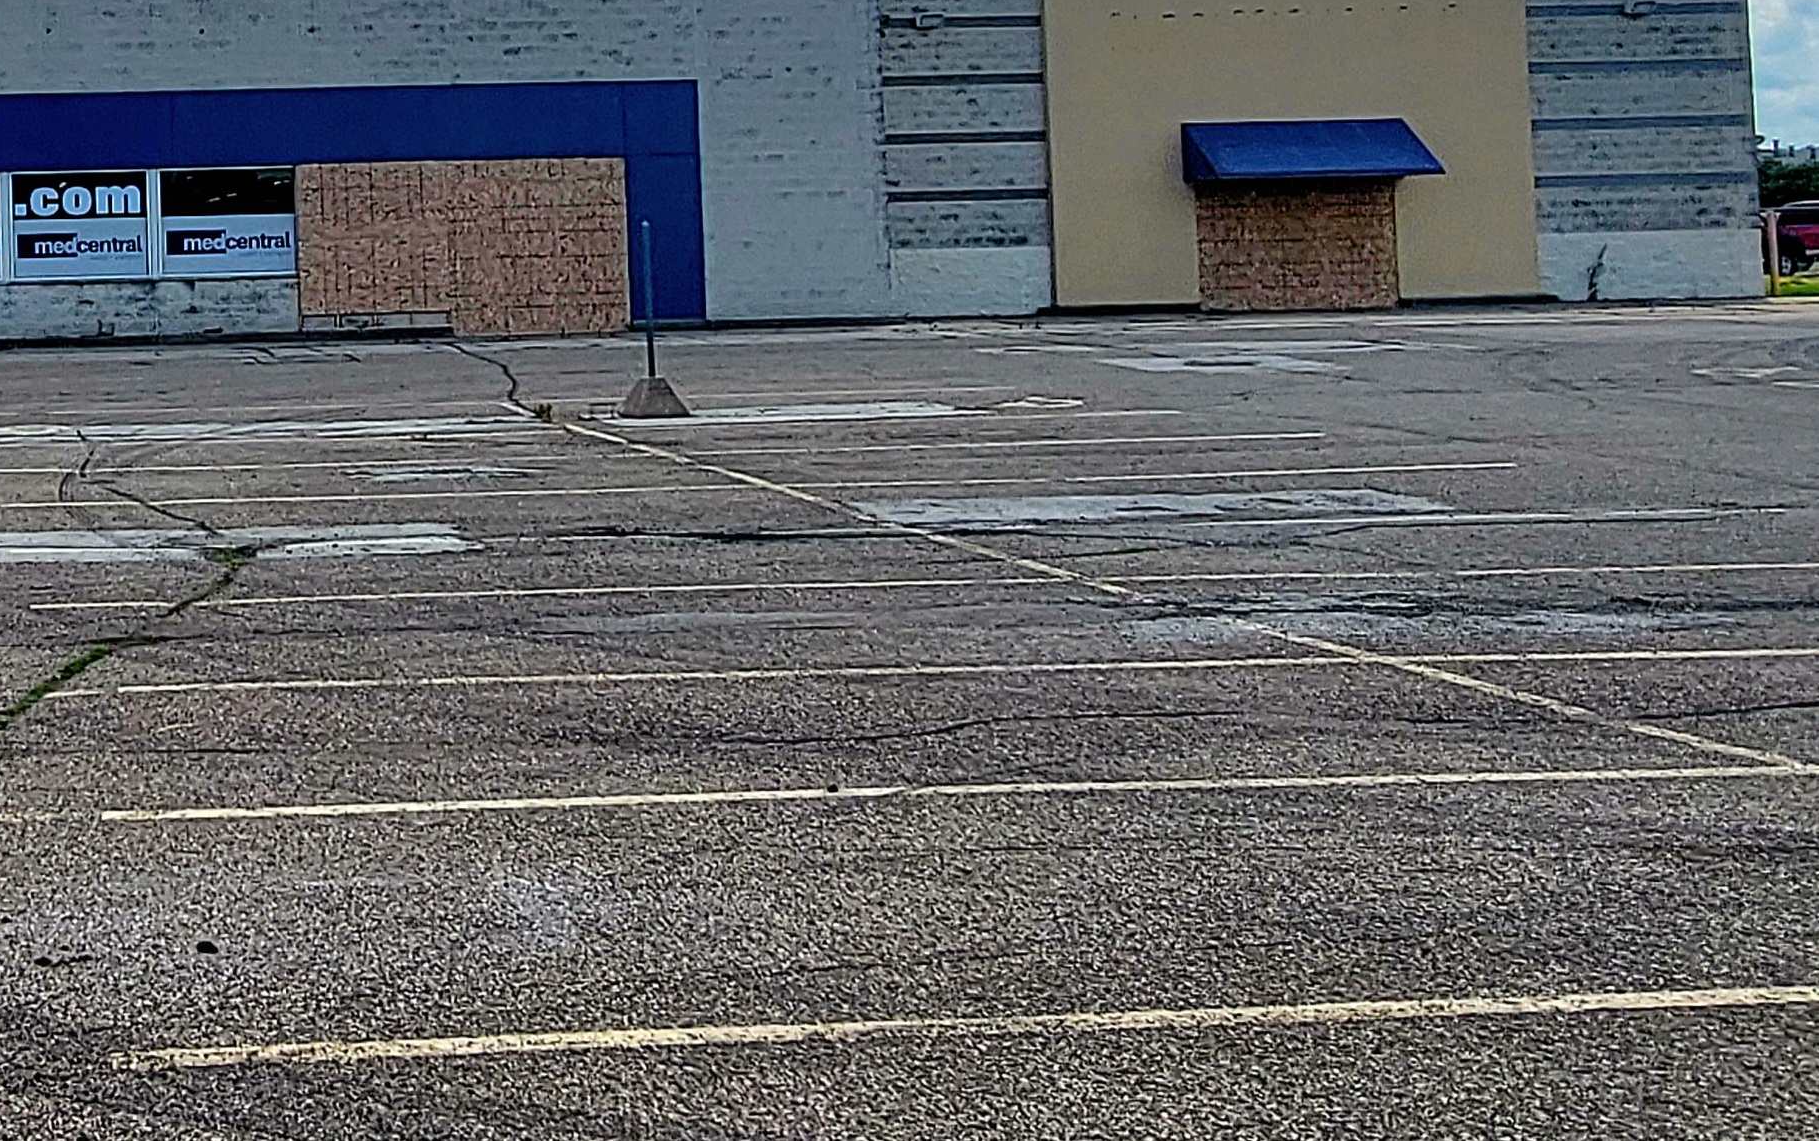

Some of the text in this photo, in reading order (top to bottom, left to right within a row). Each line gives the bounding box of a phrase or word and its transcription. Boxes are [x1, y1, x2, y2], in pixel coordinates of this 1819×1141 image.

[14, 184, 141, 216] .com
[34, 234, 143, 255] medcentral
[183, 231, 291, 251] medcentral
